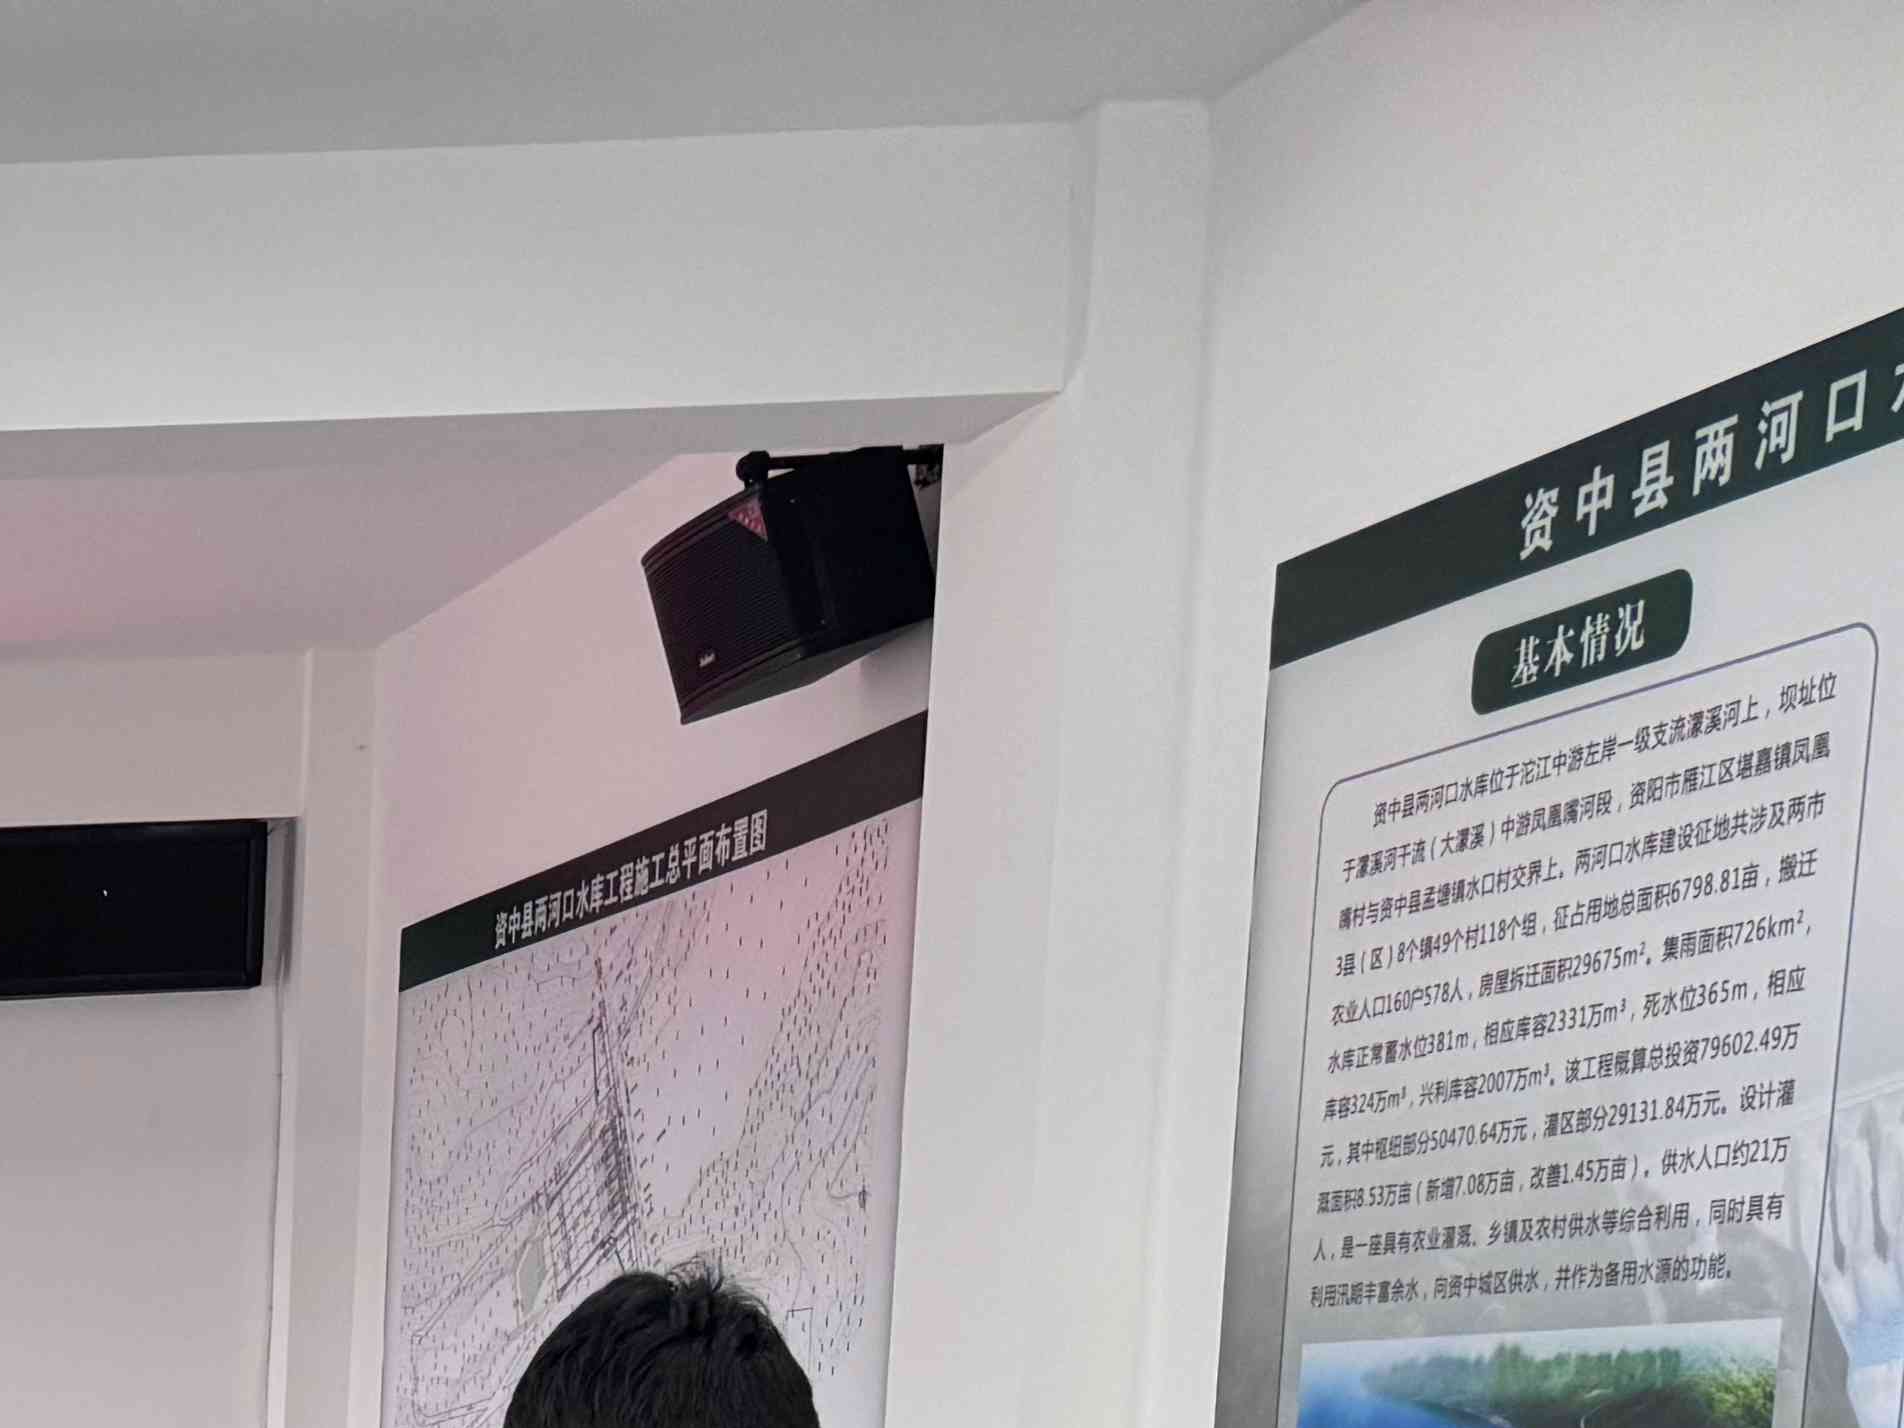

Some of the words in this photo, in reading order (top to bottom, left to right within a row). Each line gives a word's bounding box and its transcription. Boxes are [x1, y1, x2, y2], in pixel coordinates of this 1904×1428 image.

[1511, 600, 1645, 689] 基本情况
[494, 808, 768, 950] 资中县两河口水库工程施工总平面布置图
